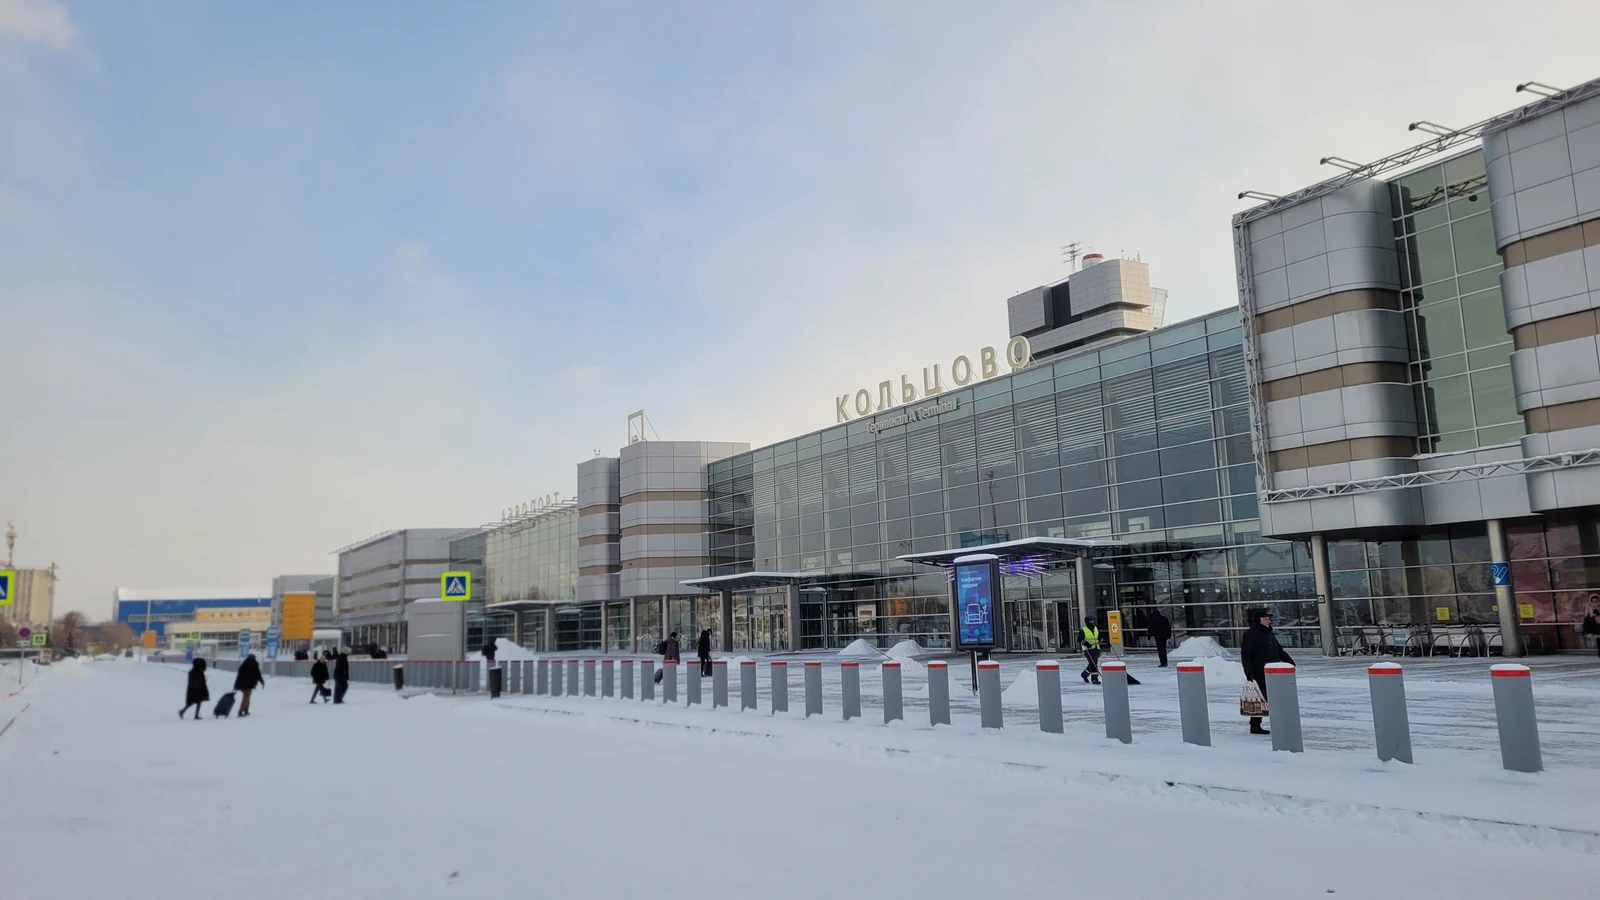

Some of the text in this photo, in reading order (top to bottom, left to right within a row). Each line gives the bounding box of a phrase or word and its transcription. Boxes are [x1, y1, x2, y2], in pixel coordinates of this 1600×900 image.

[836, 336, 1031, 423] КОЛЬЦОВО
[867, 414, 908, 433] Терминал
[917, 398, 958, 419] Terminal
